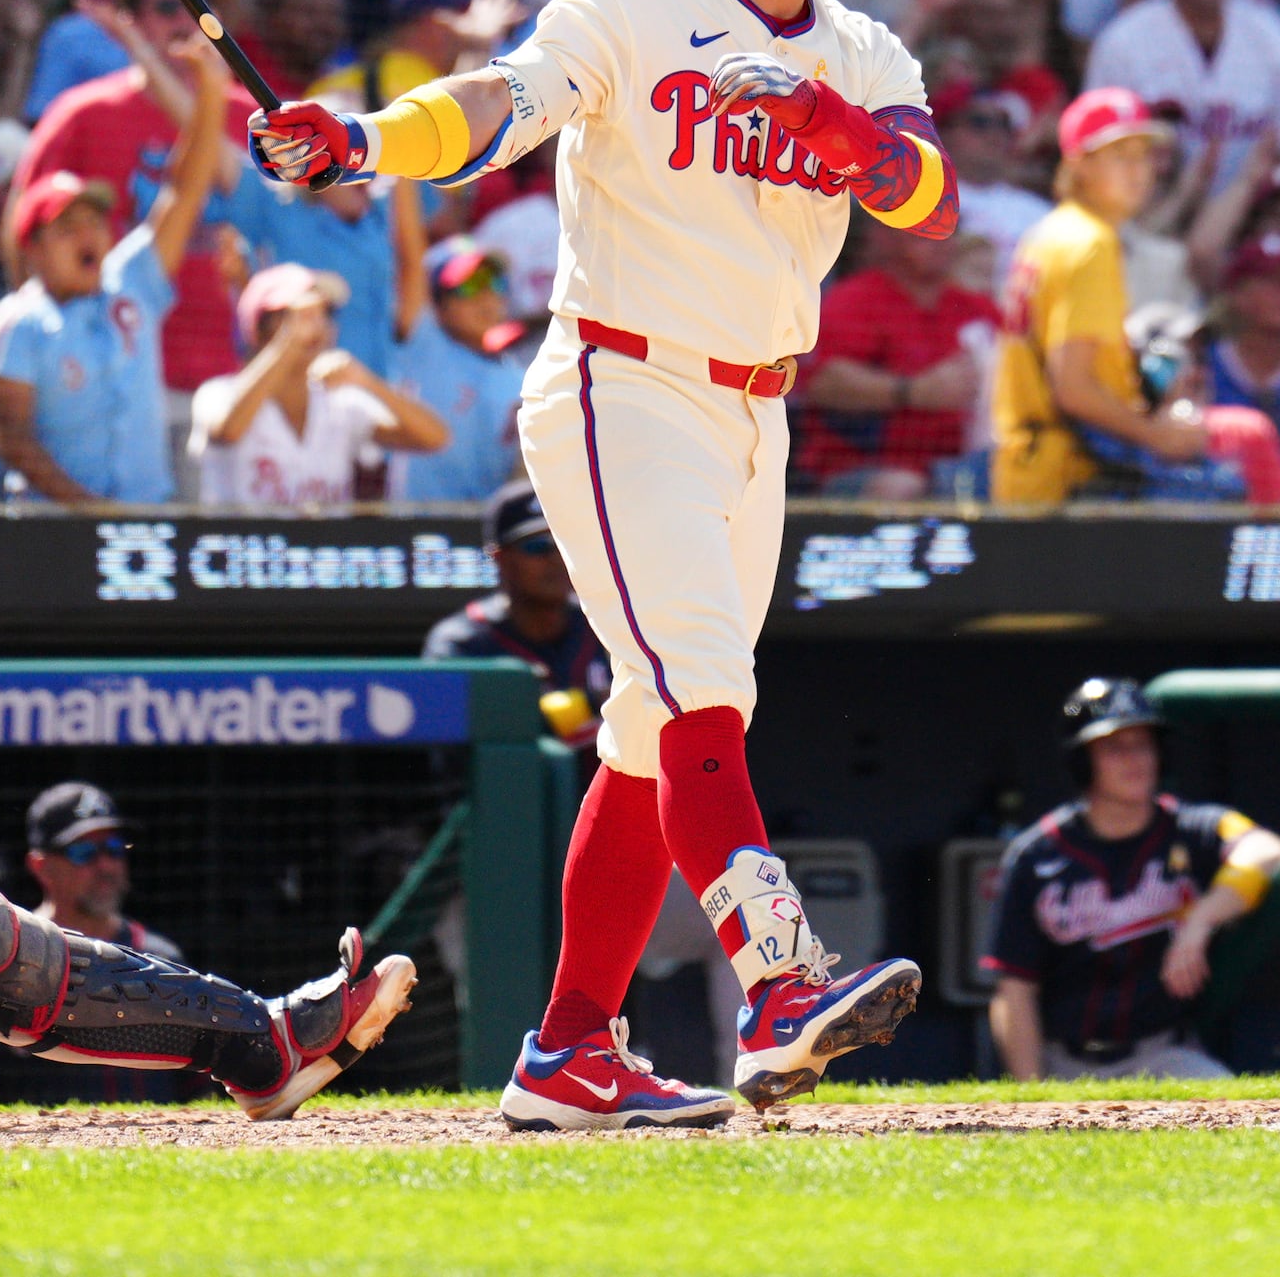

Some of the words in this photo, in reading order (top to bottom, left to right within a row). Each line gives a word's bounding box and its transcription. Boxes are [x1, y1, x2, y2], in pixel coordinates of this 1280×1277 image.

[651, 70, 848, 197] Phillie
[190, 534, 407, 589] Citizens
[756, 935, 785, 966] 12
